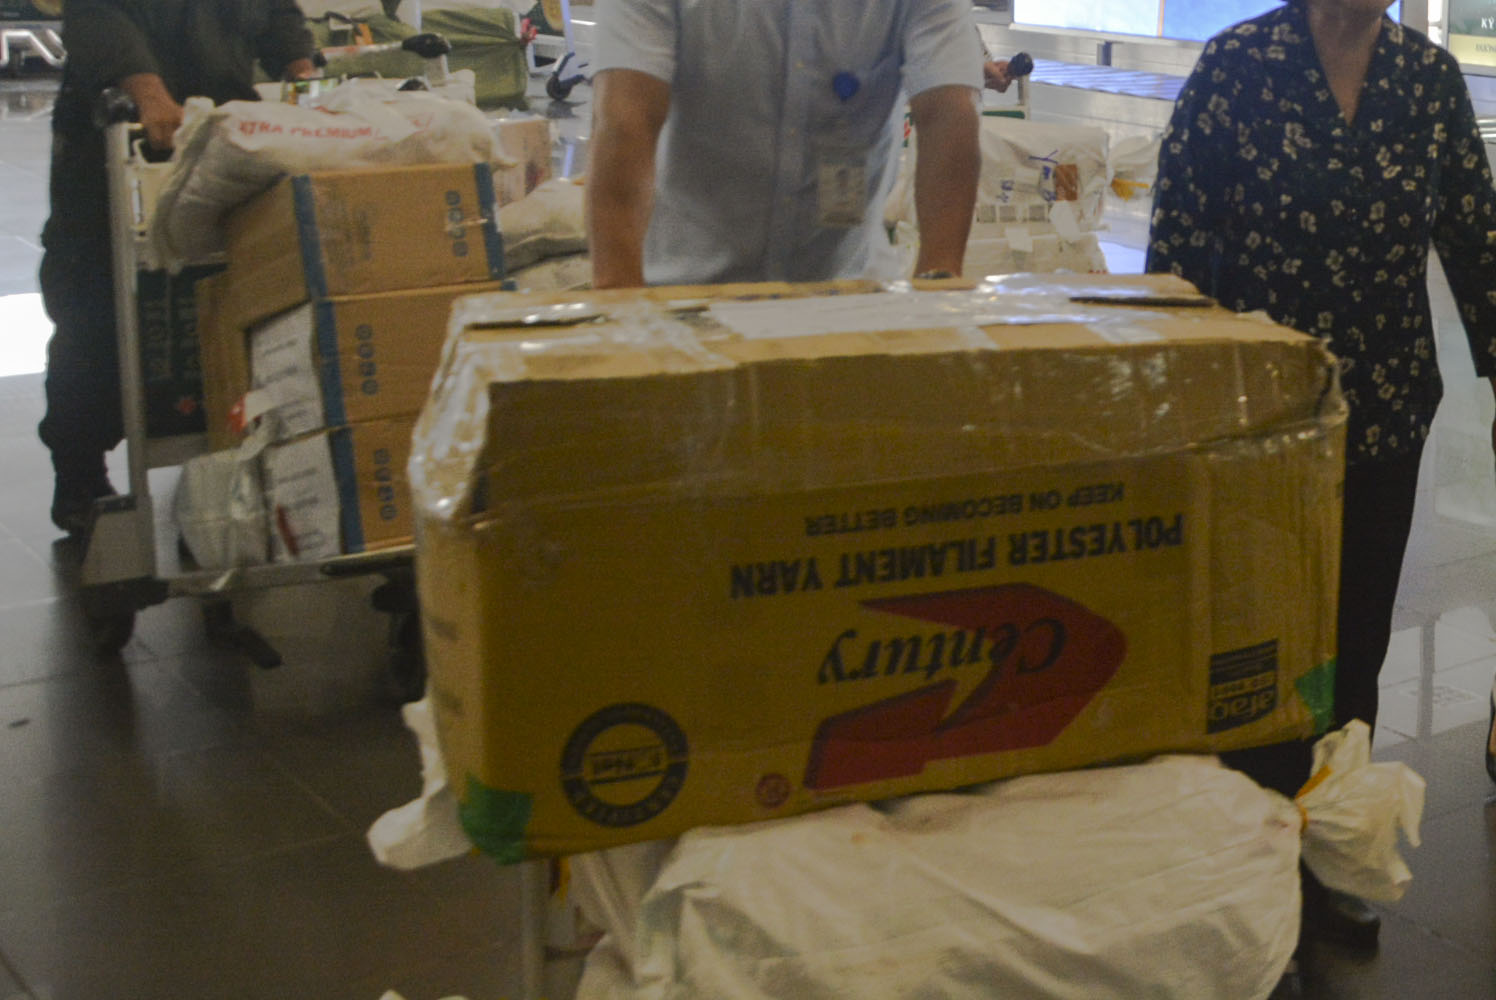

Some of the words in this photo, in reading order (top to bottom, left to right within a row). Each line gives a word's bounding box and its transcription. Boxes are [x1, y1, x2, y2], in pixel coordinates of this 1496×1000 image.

[905, 494, 1023, 529] BECOMING
[1028, 489, 1063, 512] ON
[1067, 482, 1125, 509] KEEP
[805, 509, 897, 537] BETTER
[1009, 513, 1187, 566] POLYESTER
[730, 558, 824, 599] YARN
[832, 535, 997, 588] FILAMENT
[817, 616, 1068, 687] Century
